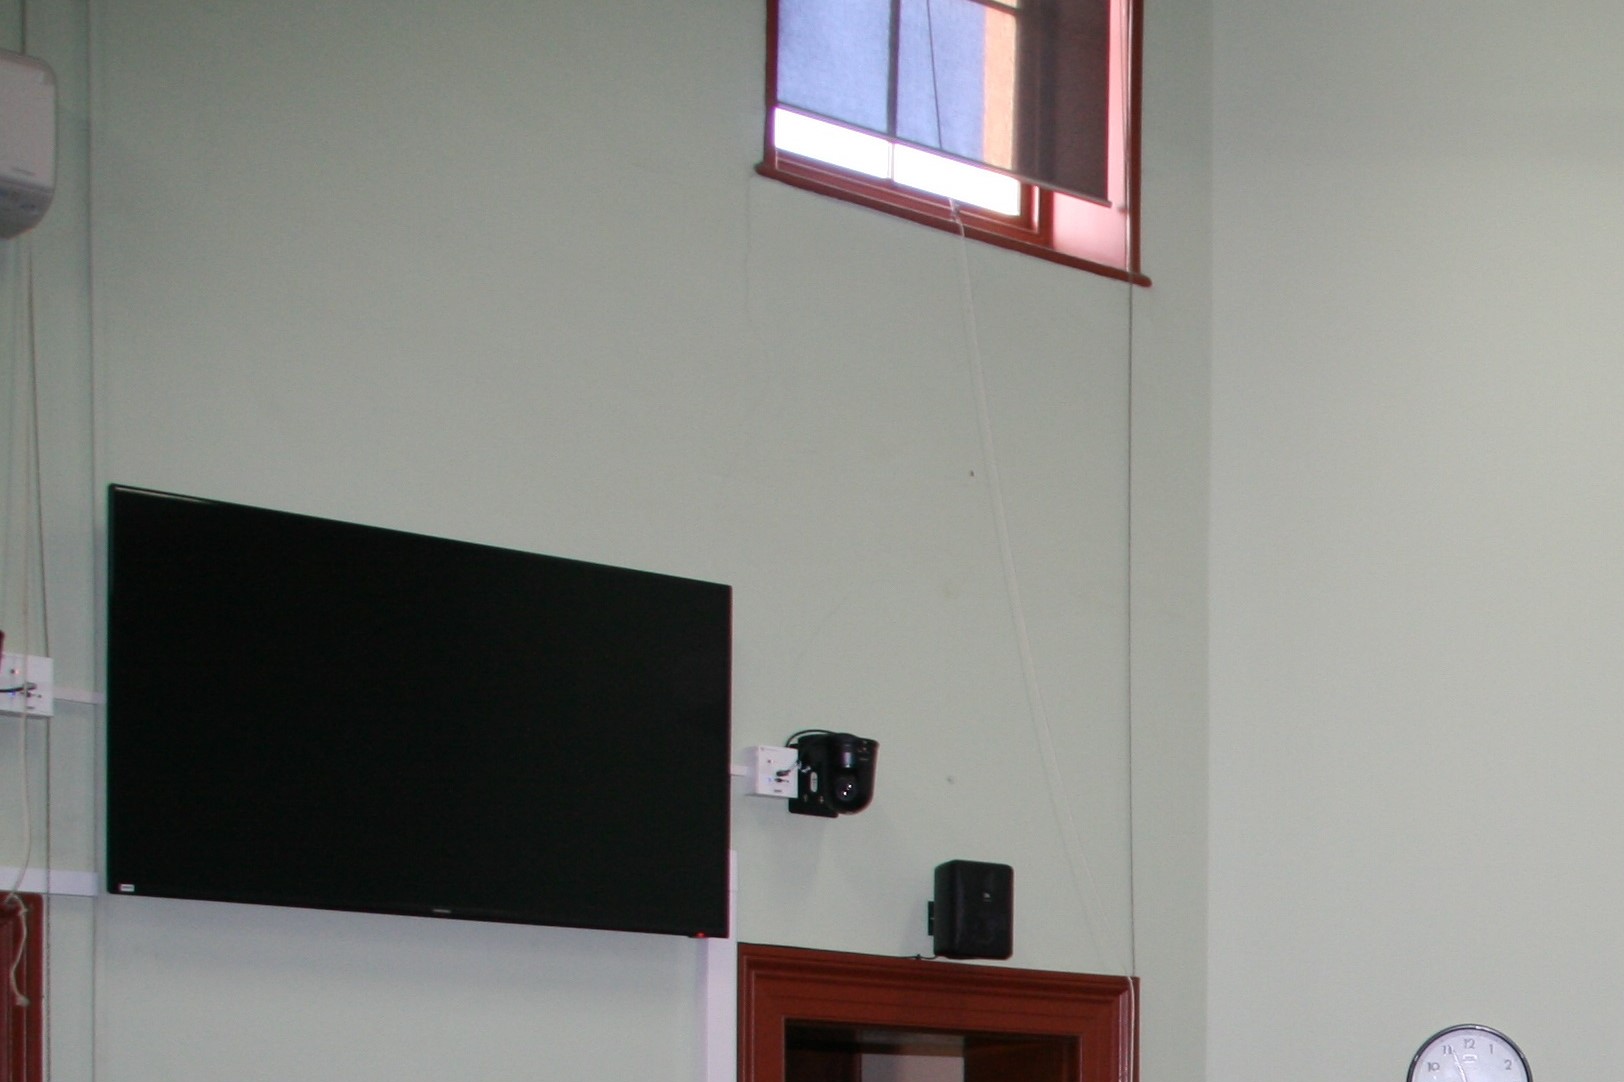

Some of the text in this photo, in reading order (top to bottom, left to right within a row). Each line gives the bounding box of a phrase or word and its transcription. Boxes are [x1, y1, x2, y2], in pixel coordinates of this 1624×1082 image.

[1442, 1045, 1453, 1055] 11
[1463, 1039, 1476, 1050] 12
[1489, 1044, 1494, 1055] 1
[1427, 1062, 1440, 1072] 10
[1504, 1059, 1512, 1071] 2
